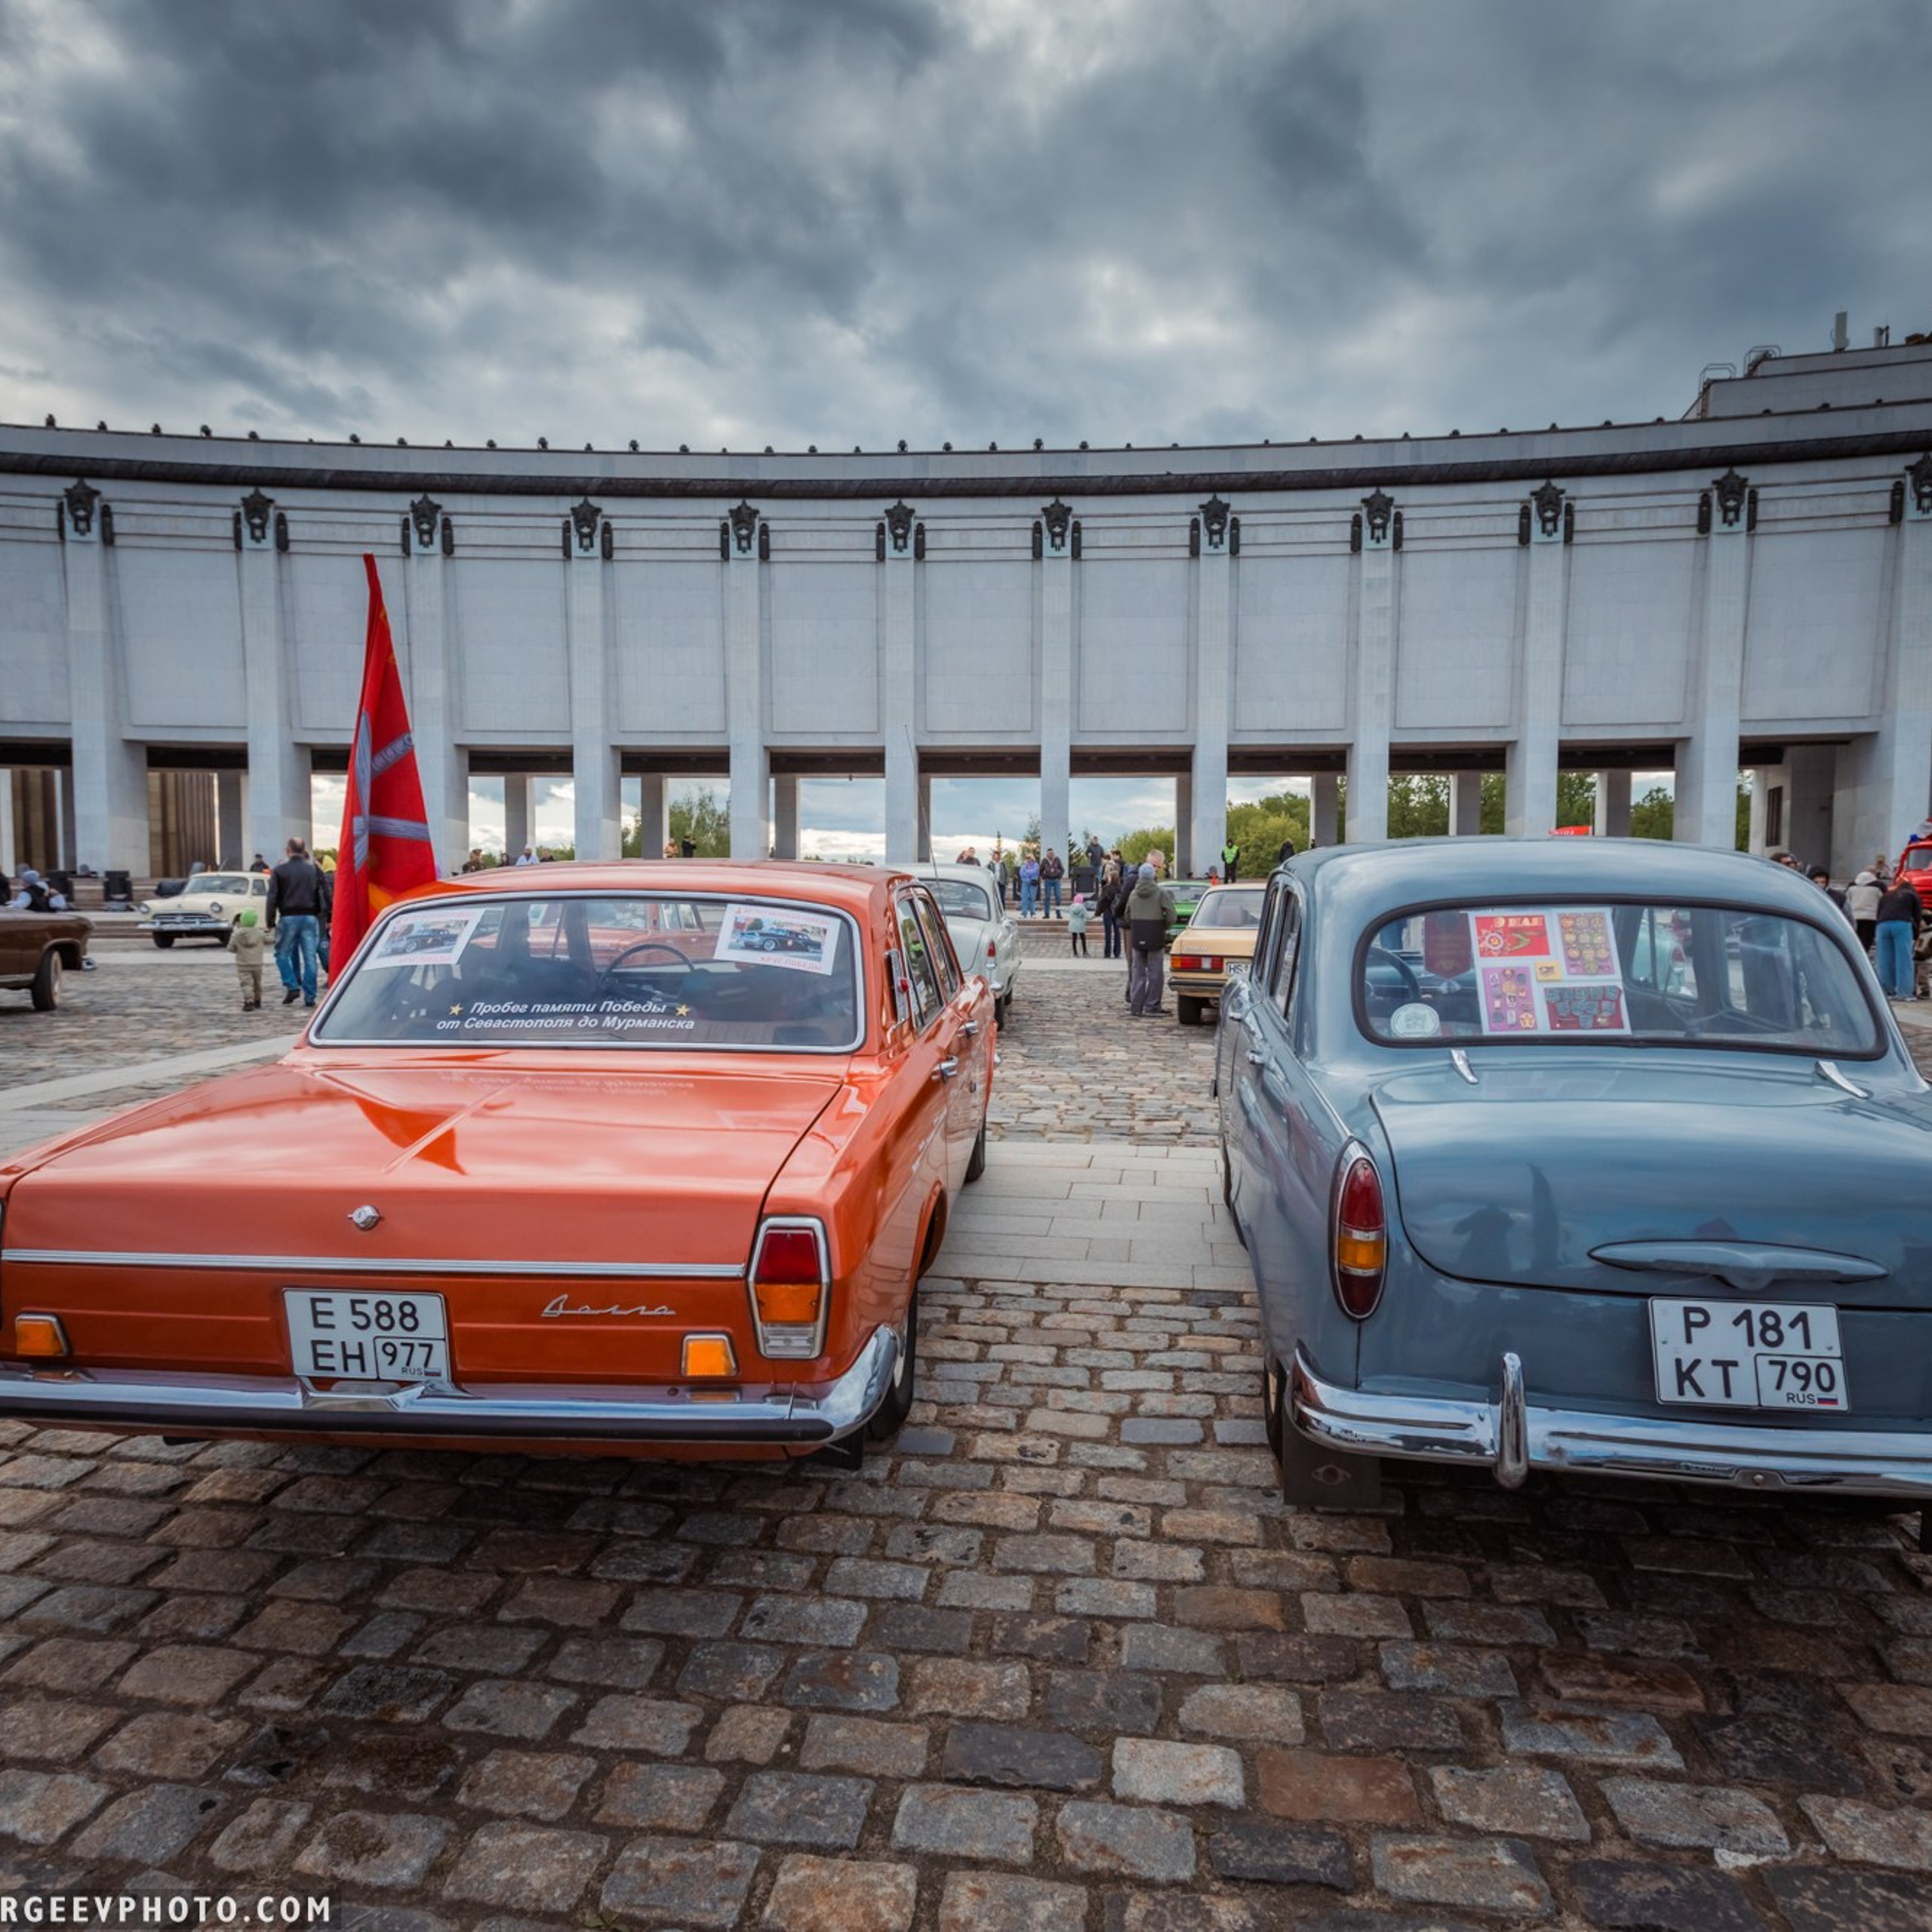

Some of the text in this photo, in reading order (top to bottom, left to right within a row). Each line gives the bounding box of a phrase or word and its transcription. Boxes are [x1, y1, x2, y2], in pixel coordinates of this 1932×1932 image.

[470, 1000, 667, 1015] Пробег памяти Победы
[436, 1015, 695, 1030] от Севастополя до Мурманска
[349, 1299, 419, 1332] 588
[1731, 1309, 1812, 1350] 181
[381, 1341, 434, 1368] 977
[401, 1367, 423, 1377] RUS
[1768, 1359, 1836, 1392] 790
[1786, 1392, 1817, 1404] RUS
